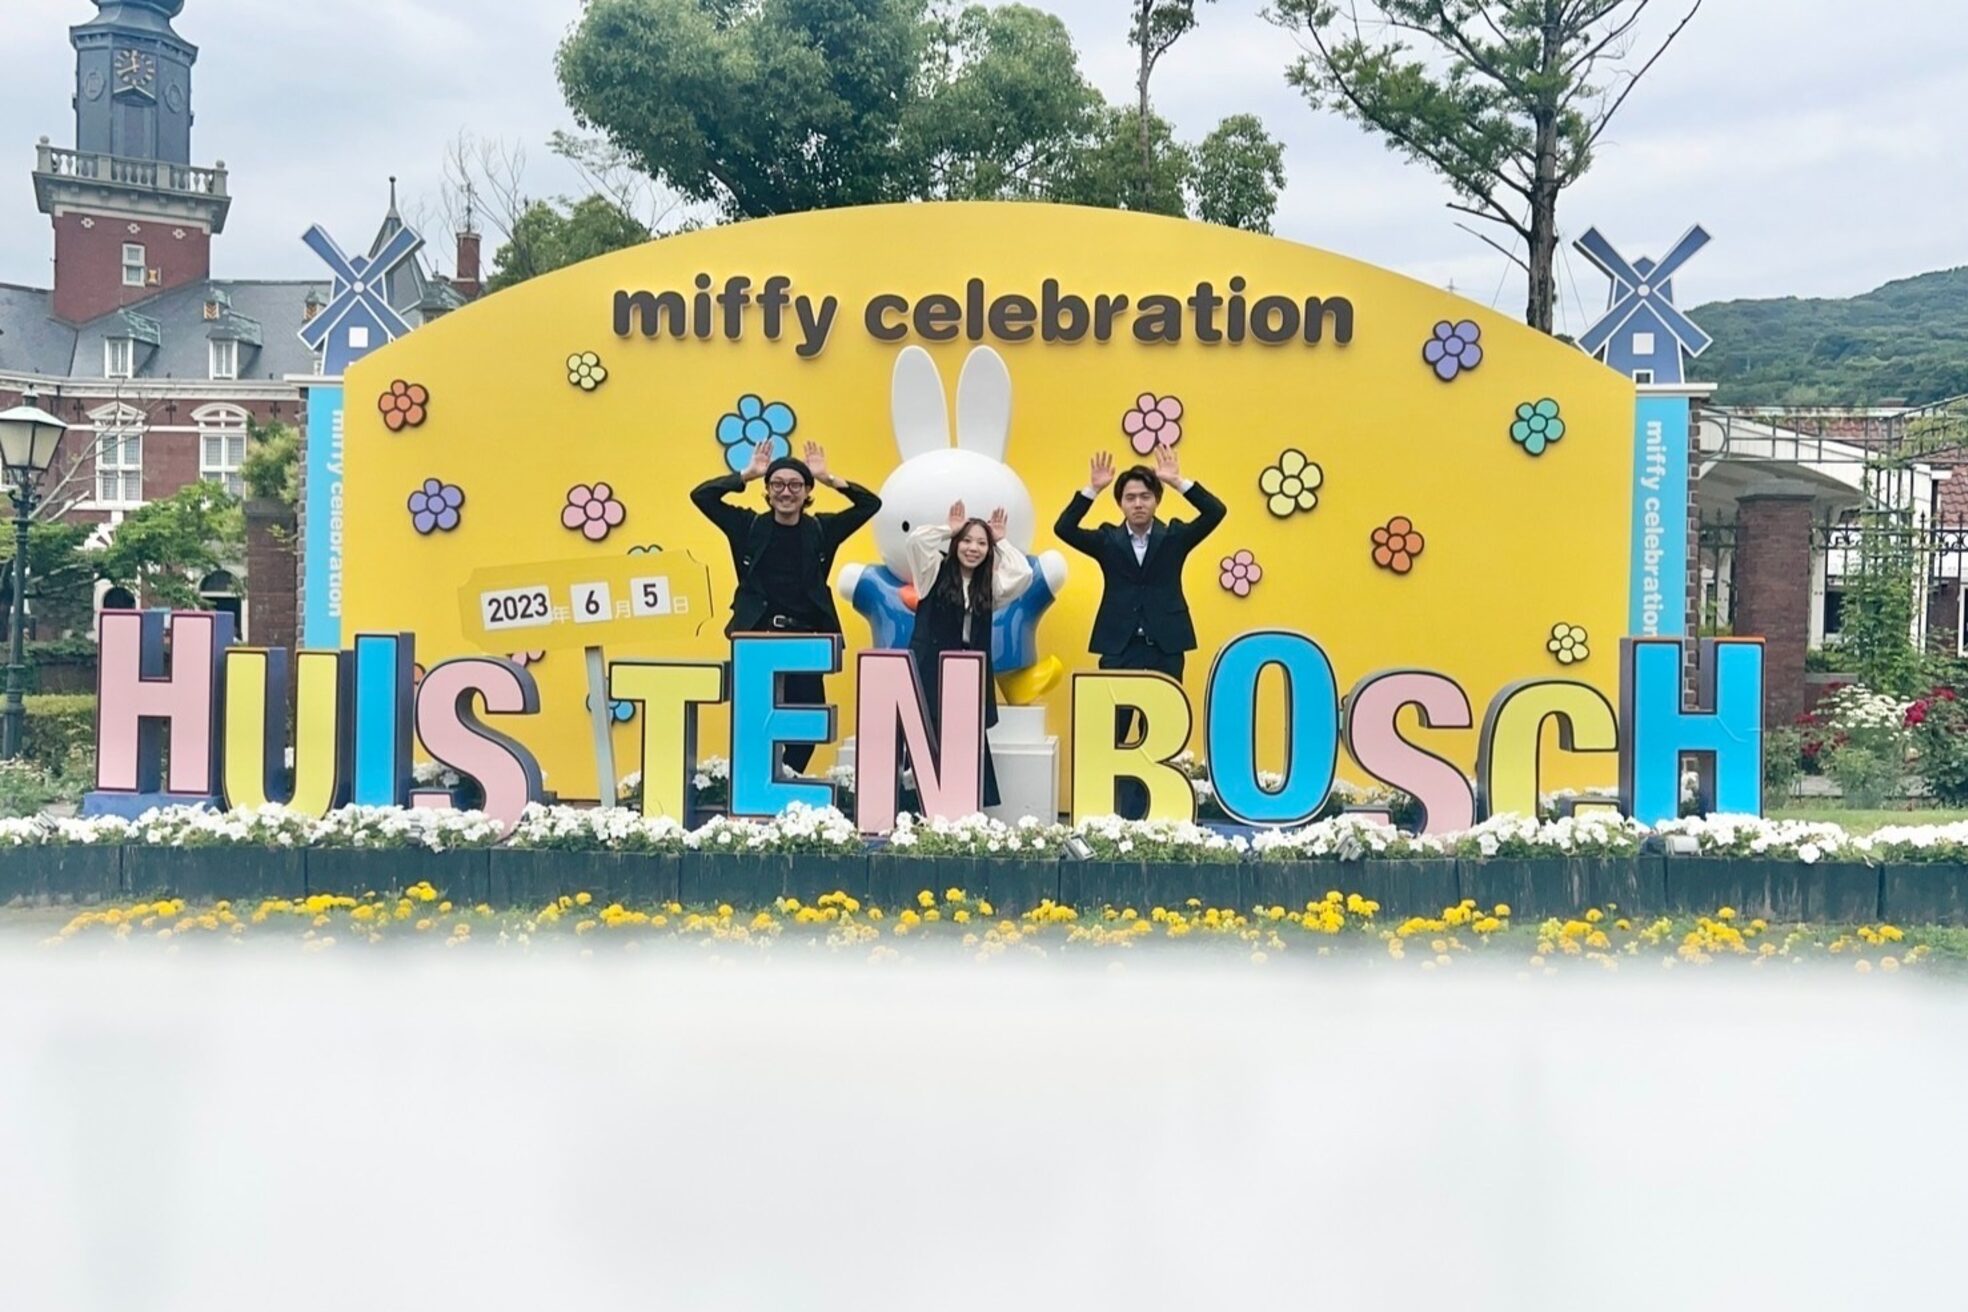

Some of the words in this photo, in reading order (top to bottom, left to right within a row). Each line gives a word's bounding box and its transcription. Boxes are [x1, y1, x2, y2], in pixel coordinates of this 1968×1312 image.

[612, 273, 838, 357] miffy
[863, 276, 1354, 344] celebration
[1640, 420, 1667, 490] miffy
[1642, 497, 1665, 637] celebration
[96, 608, 542, 838] HUIS
[610, 632, 987, 834] TEN
[1070, 630, 1766, 832] BOSCH
